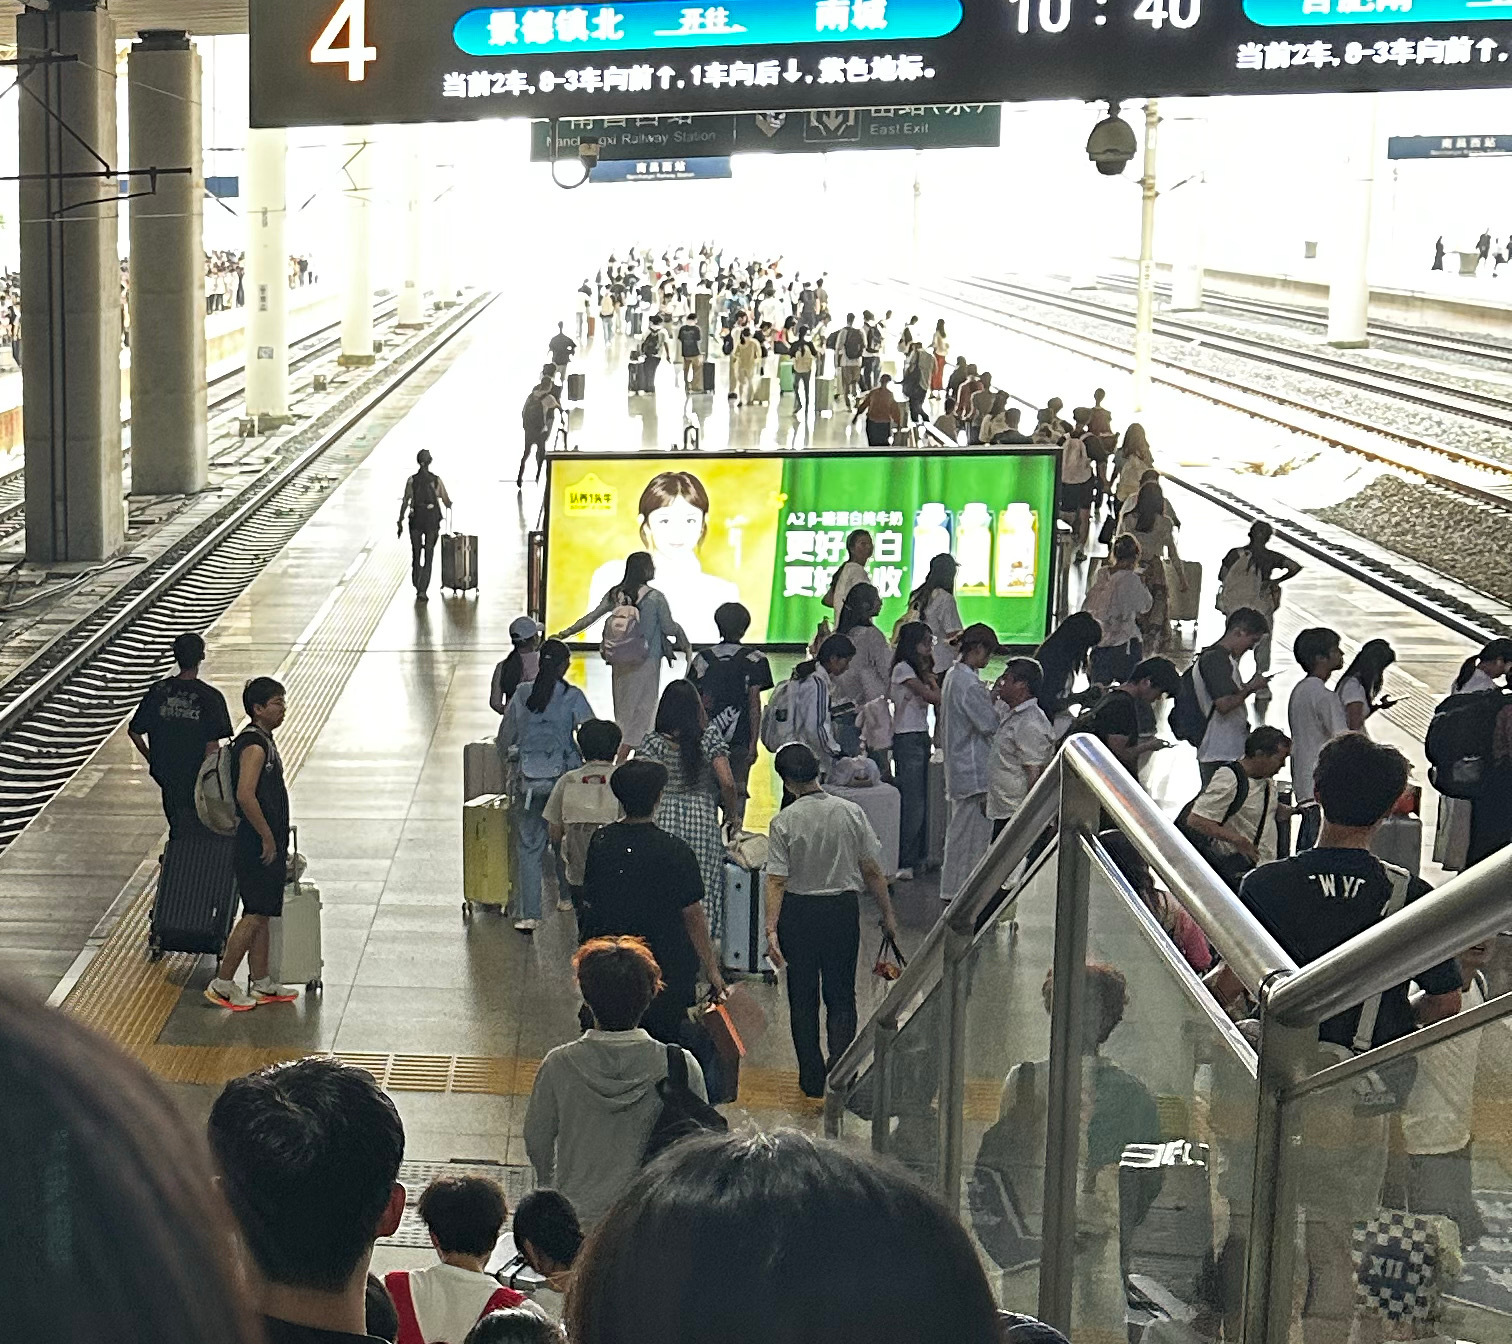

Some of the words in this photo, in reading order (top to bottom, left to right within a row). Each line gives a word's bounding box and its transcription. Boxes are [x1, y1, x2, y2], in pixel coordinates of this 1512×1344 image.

[869, 123, 900, 135] East
[903, 122, 929, 134] Exit
[784, 530, 903, 562] 更好白
